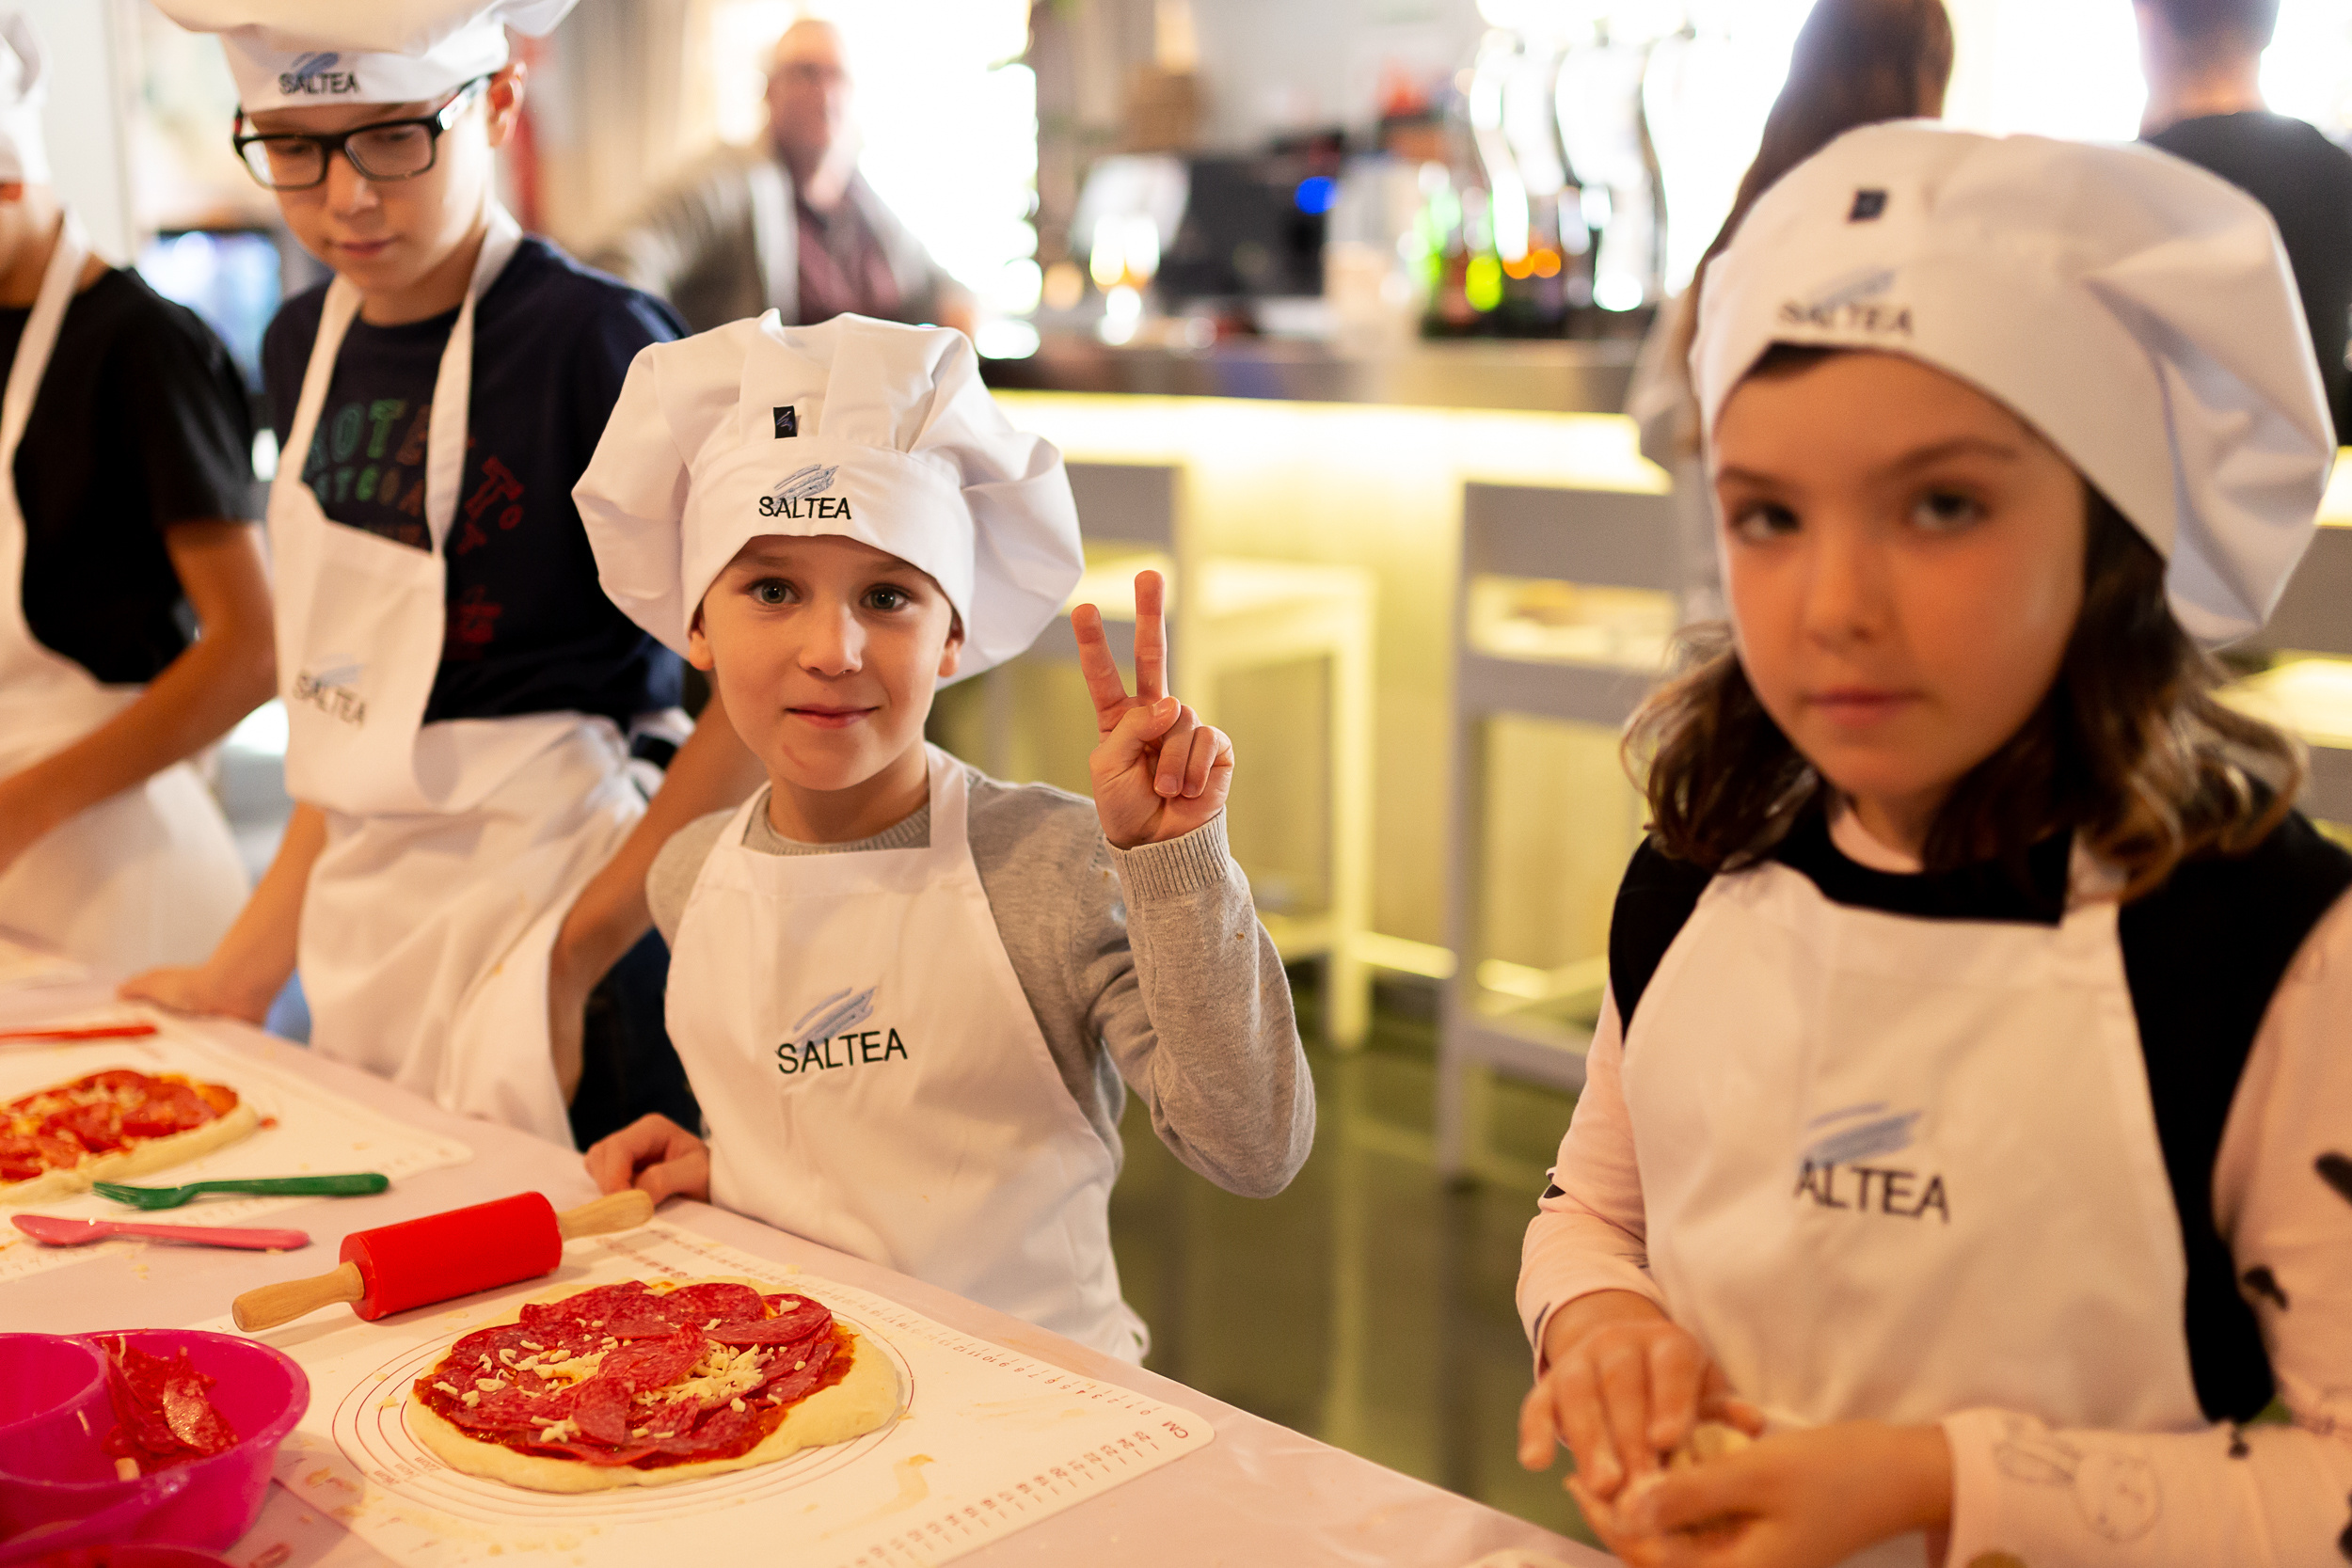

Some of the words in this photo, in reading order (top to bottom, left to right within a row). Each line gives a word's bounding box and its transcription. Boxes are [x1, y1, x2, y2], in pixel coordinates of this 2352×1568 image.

[278, 71, 361, 95] SALTEA
[758, 496, 851, 520] SALTEA
[776, 1027, 908, 1074] SALTEA
[882, 1315, 897, 1323] 17
[896, 1322, 910, 1330] 16
[1162, 1420, 1188, 1439] CM
[1132, 1431, 1151, 1442] 25
[1117, 1438, 1135, 1449] 24
[1100, 1445, 1118, 1456] 23
